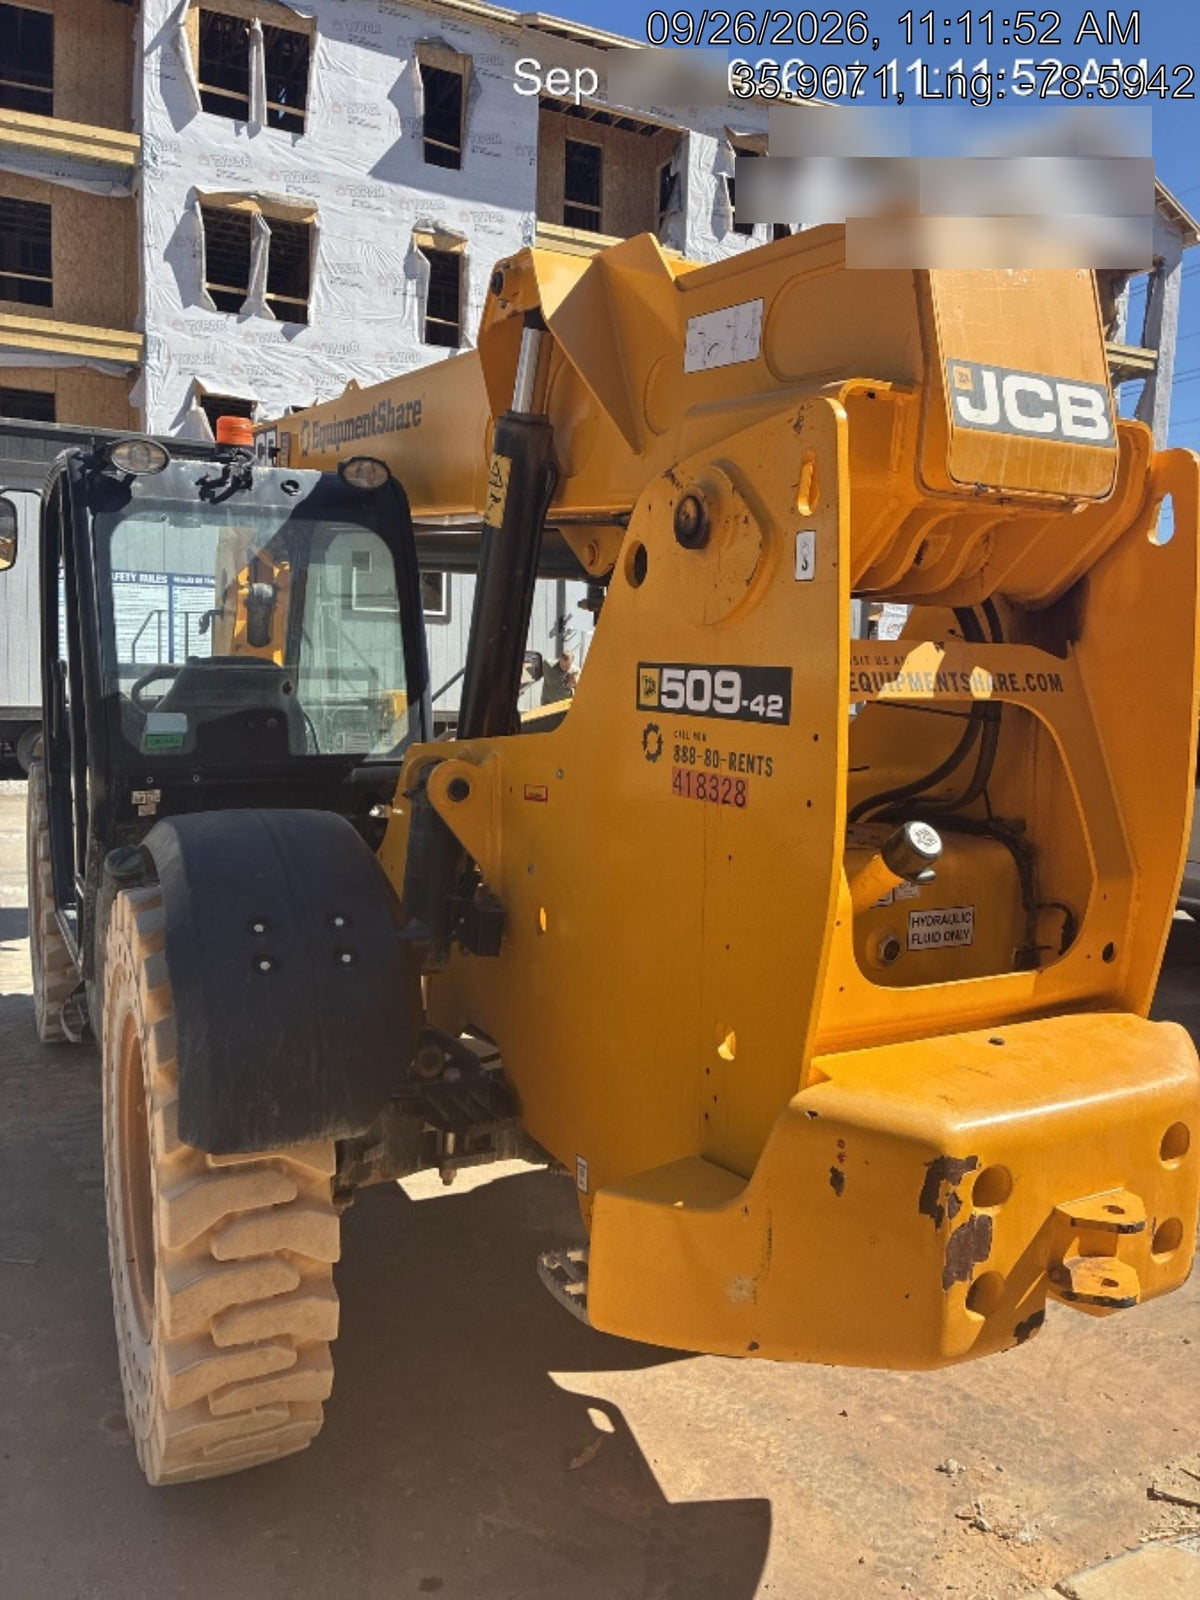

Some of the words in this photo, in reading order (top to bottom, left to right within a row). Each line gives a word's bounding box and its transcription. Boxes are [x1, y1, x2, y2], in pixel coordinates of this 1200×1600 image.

[956, 370, 1110, 440] JCB
[312, 399, 422, 453] EquipmentShare
[139, 573, 168, 583] RULES
[661, 668, 783, 718] 509-42
[850, 671, 1064, 693] EQUIPMENTSHARE.COM
[673, 745, 774, 777] 888-80-RENTS
[673, 769, 747, 807] 418328
[911, 911, 972, 928] HYDRAULIC
[911, 932, 941, 945] FLUID
[943, 929, 970, 941] ONLY
